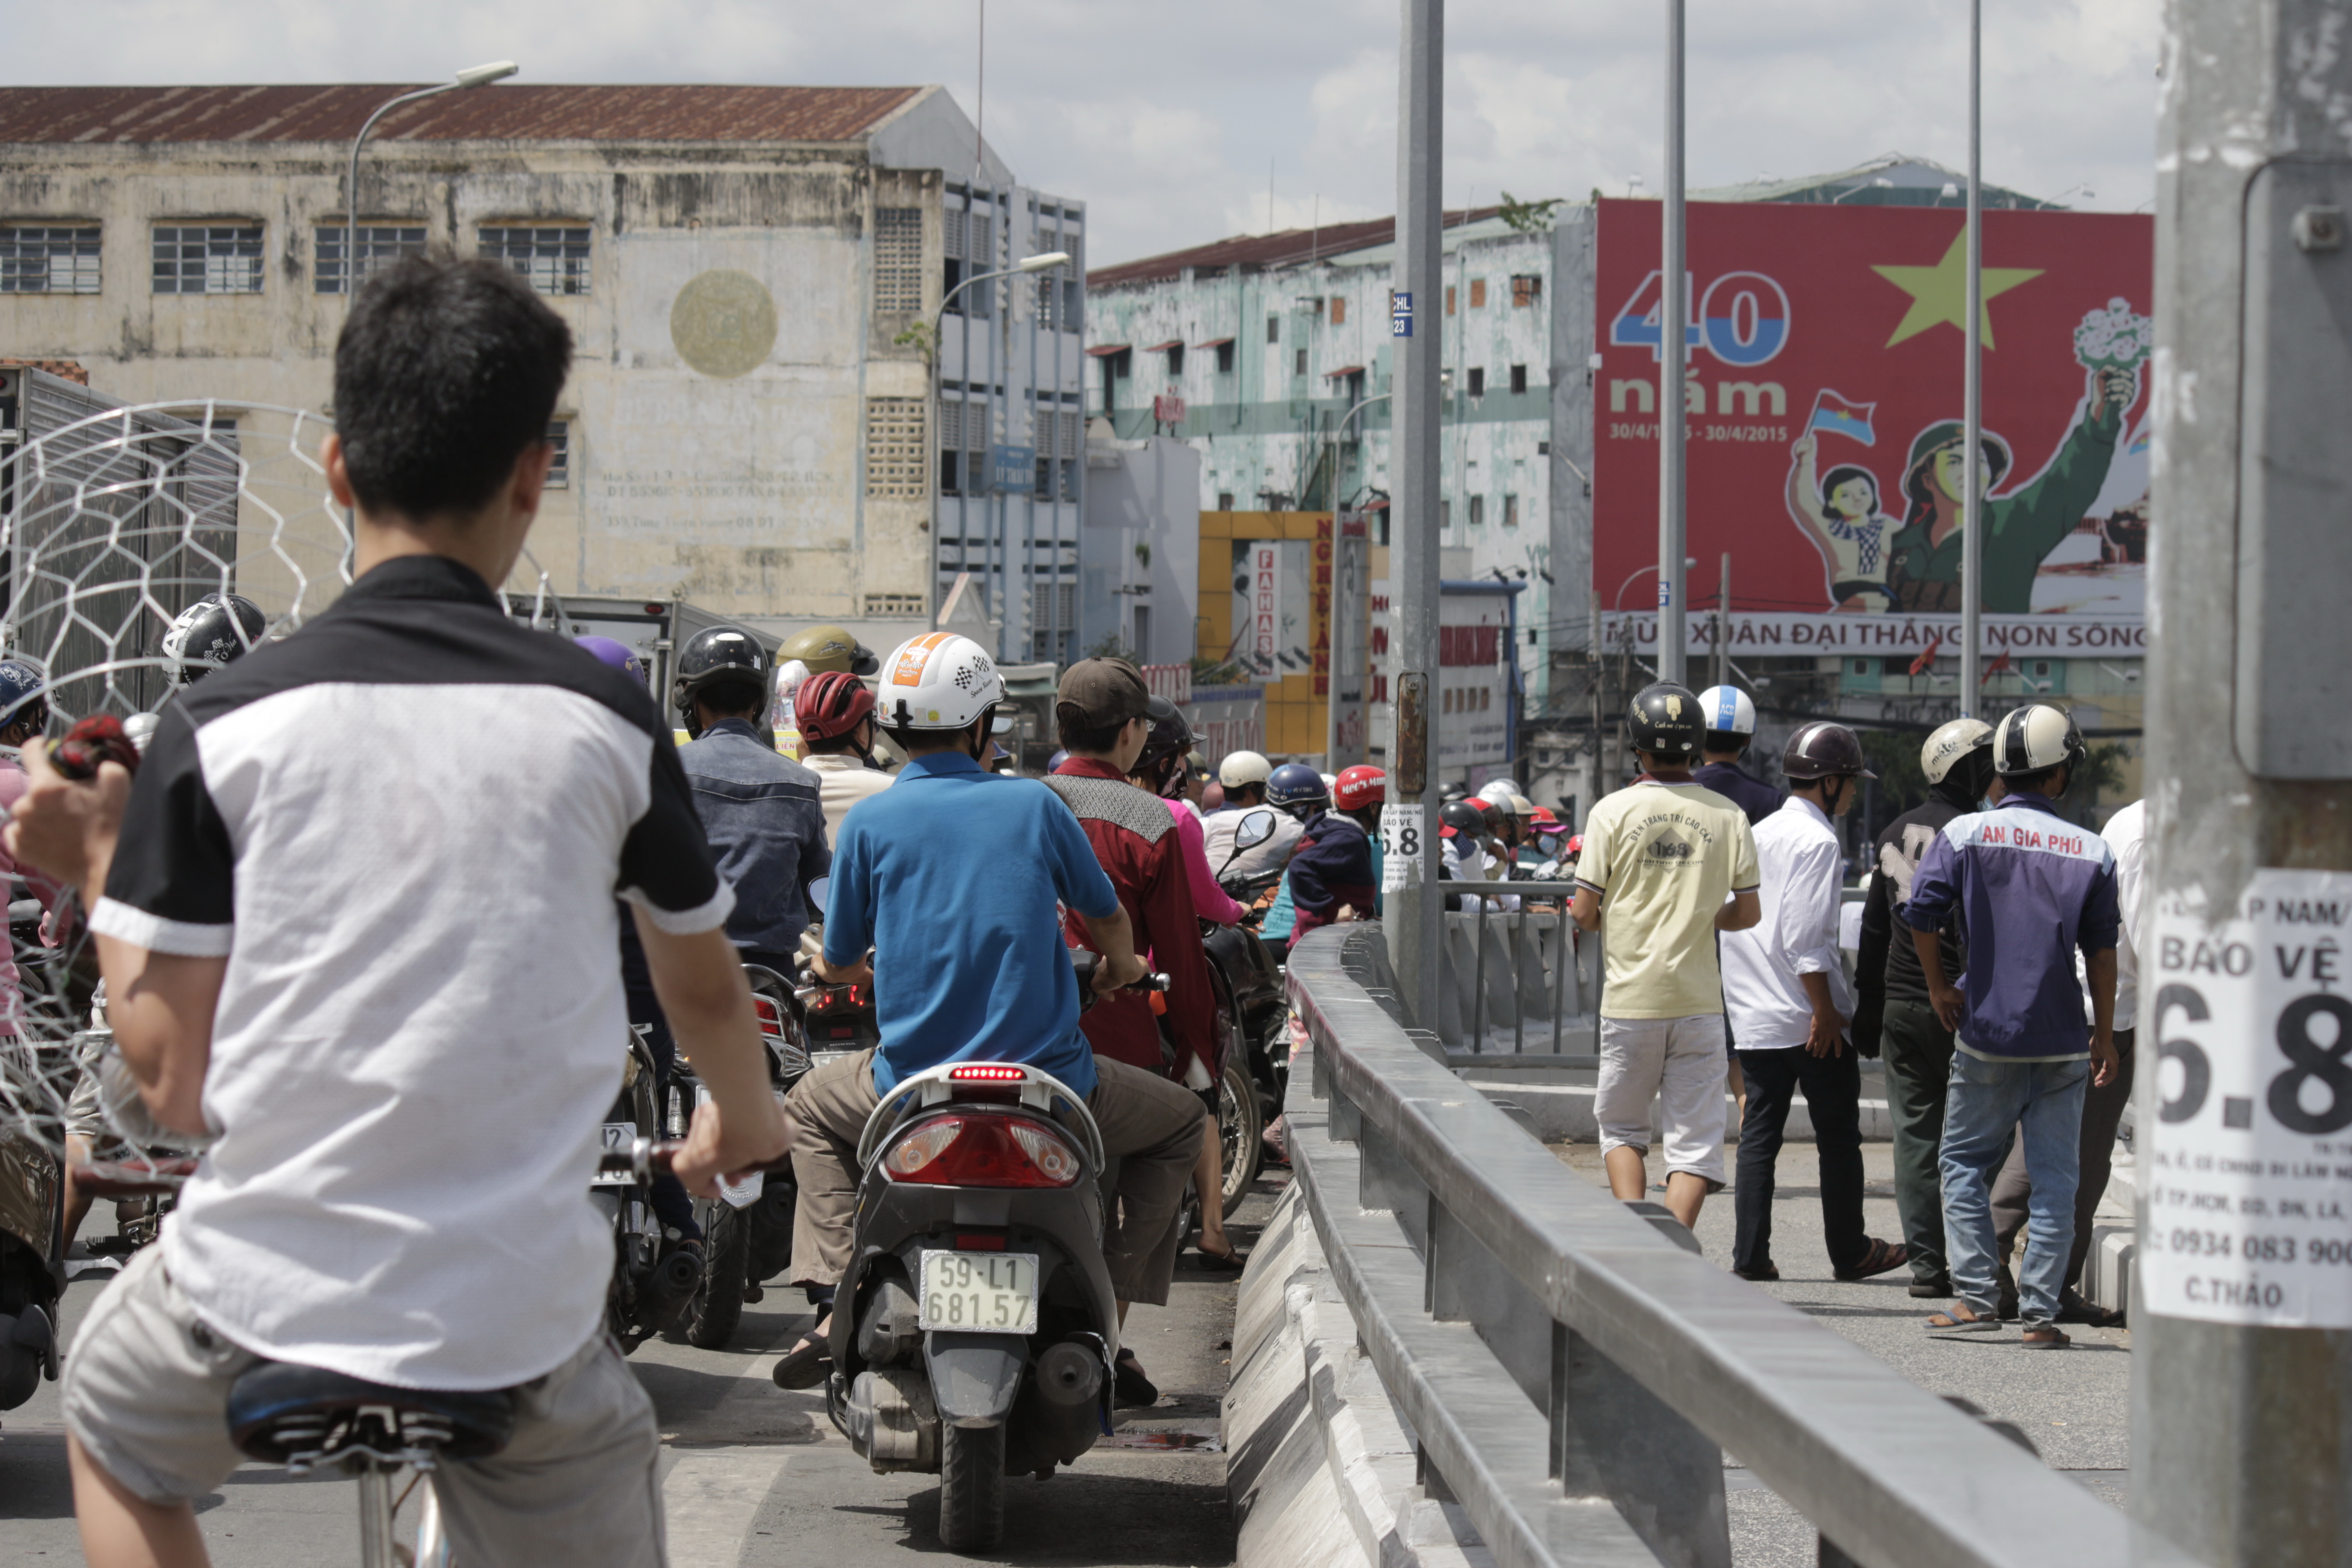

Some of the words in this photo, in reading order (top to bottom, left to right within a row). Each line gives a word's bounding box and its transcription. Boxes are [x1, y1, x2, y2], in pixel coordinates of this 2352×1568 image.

[1394, 319, 1404, 333] 23
[1610, 270, 1790, 367] 40
[1610, 423, 1692, 439] 30/4/15
[1705, 425, 1787, 441] 30/4/2015
[1791, 623, 1846, 651] ĐẠI
[1988, 625, 2057, 646] NON
[970, 686, 982, 699] Space
[1720, 704, 1735, 715] ACB
[1399, 816, 1413, 828] VỆ
[1642, 813, 1668, 827] TRANG
[1670, 813, 1685, 823] TRÍ
[1685, 817, 1700, 829] CAO
[1655, 841, 1688, 857] 168
[1982, 825, 2005, 843] AN
[2014, 828, 2042, 848] GIA
[2048, 834, 2082, 855] PHÚ
[2275, 936, 2340, 992] VỆ
[2155, 983, 2352, 1135] 6.8
[2171, 1227, 2231, 1257] 0934
[2242, 1235, 2296, 1262] 083
[940, 1257, 1016, 1290] 59-L1
[2185, 1272, 2283, 1308] C.THẢO
[928, 1292, 1029, 1327] 681.57
